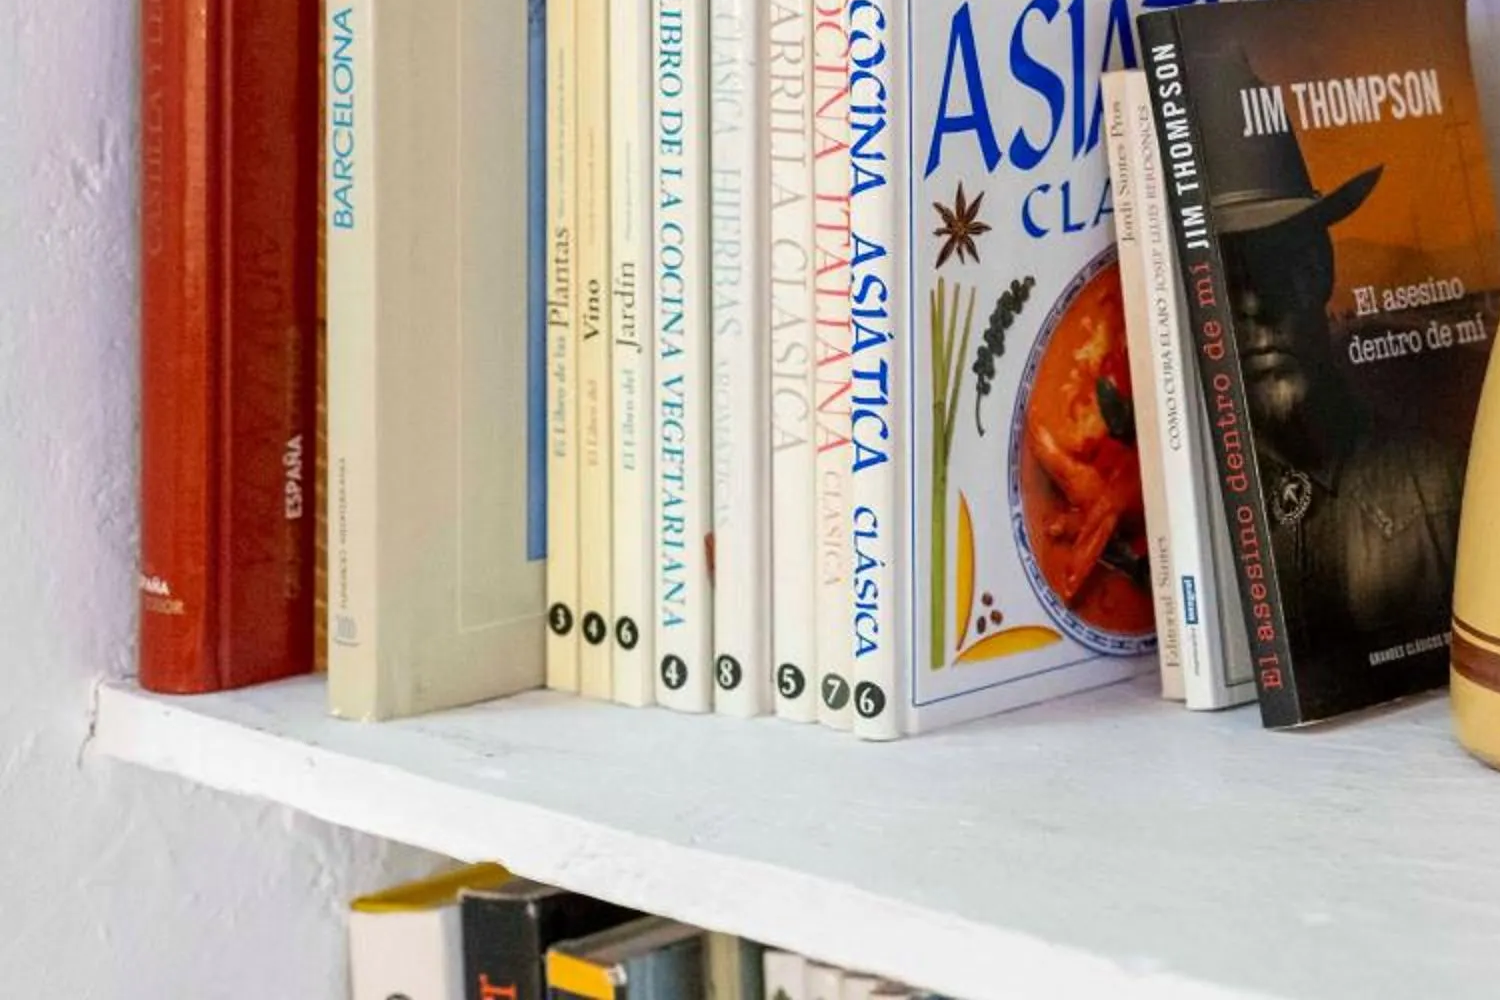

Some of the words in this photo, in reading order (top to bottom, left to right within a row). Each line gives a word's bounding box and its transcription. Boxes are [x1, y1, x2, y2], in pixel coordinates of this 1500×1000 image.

[331, 8, 355, 230] BARCELONA
[659, 109, 684, 158] DE
[1152, 43, 1199, 197] THOMPSON
[1239, 87, 1289, 137] JIM
[1290, 69, 1443, 130] THOMPSON
[659, 167, 685, 211] LA
[1182, 204, 1210, 250] JIM
[547, 225, 571, 329] Plantas
[660, 221, 685, 360] COCINA
[712, 168, 742, 338] HIERBAS
[1190, 262, 1218, 306] mí
[1352, 285, 1379, 317] El
[1382, 276, 1465, 312] asesino
[582, 279, 602, 342] Vino
[614, 260, 643, 355] Jardín
[814, 193, 852, 455] ITALIANA
[851, 230, 894, 474] ASIÁTICA
[1202, 321, 1224, 360] de
[1347, 327, 1422, 366] dentro
[1425, 321, 1454, 348] de
[1456, 313, 1488, 342] mí
[1159, 351, 1176, 395] CURA
[281, 434, 304, 519] ESPAÑA
[1211, 373, 1248, 492] dentro
[660, 375, 688, 629] VEGETARIANA
[854, 506, 886, 658] CLÁSICA
[1233, 506, 1275, 643] asesino
[1258, 655, 1283, 690] El
